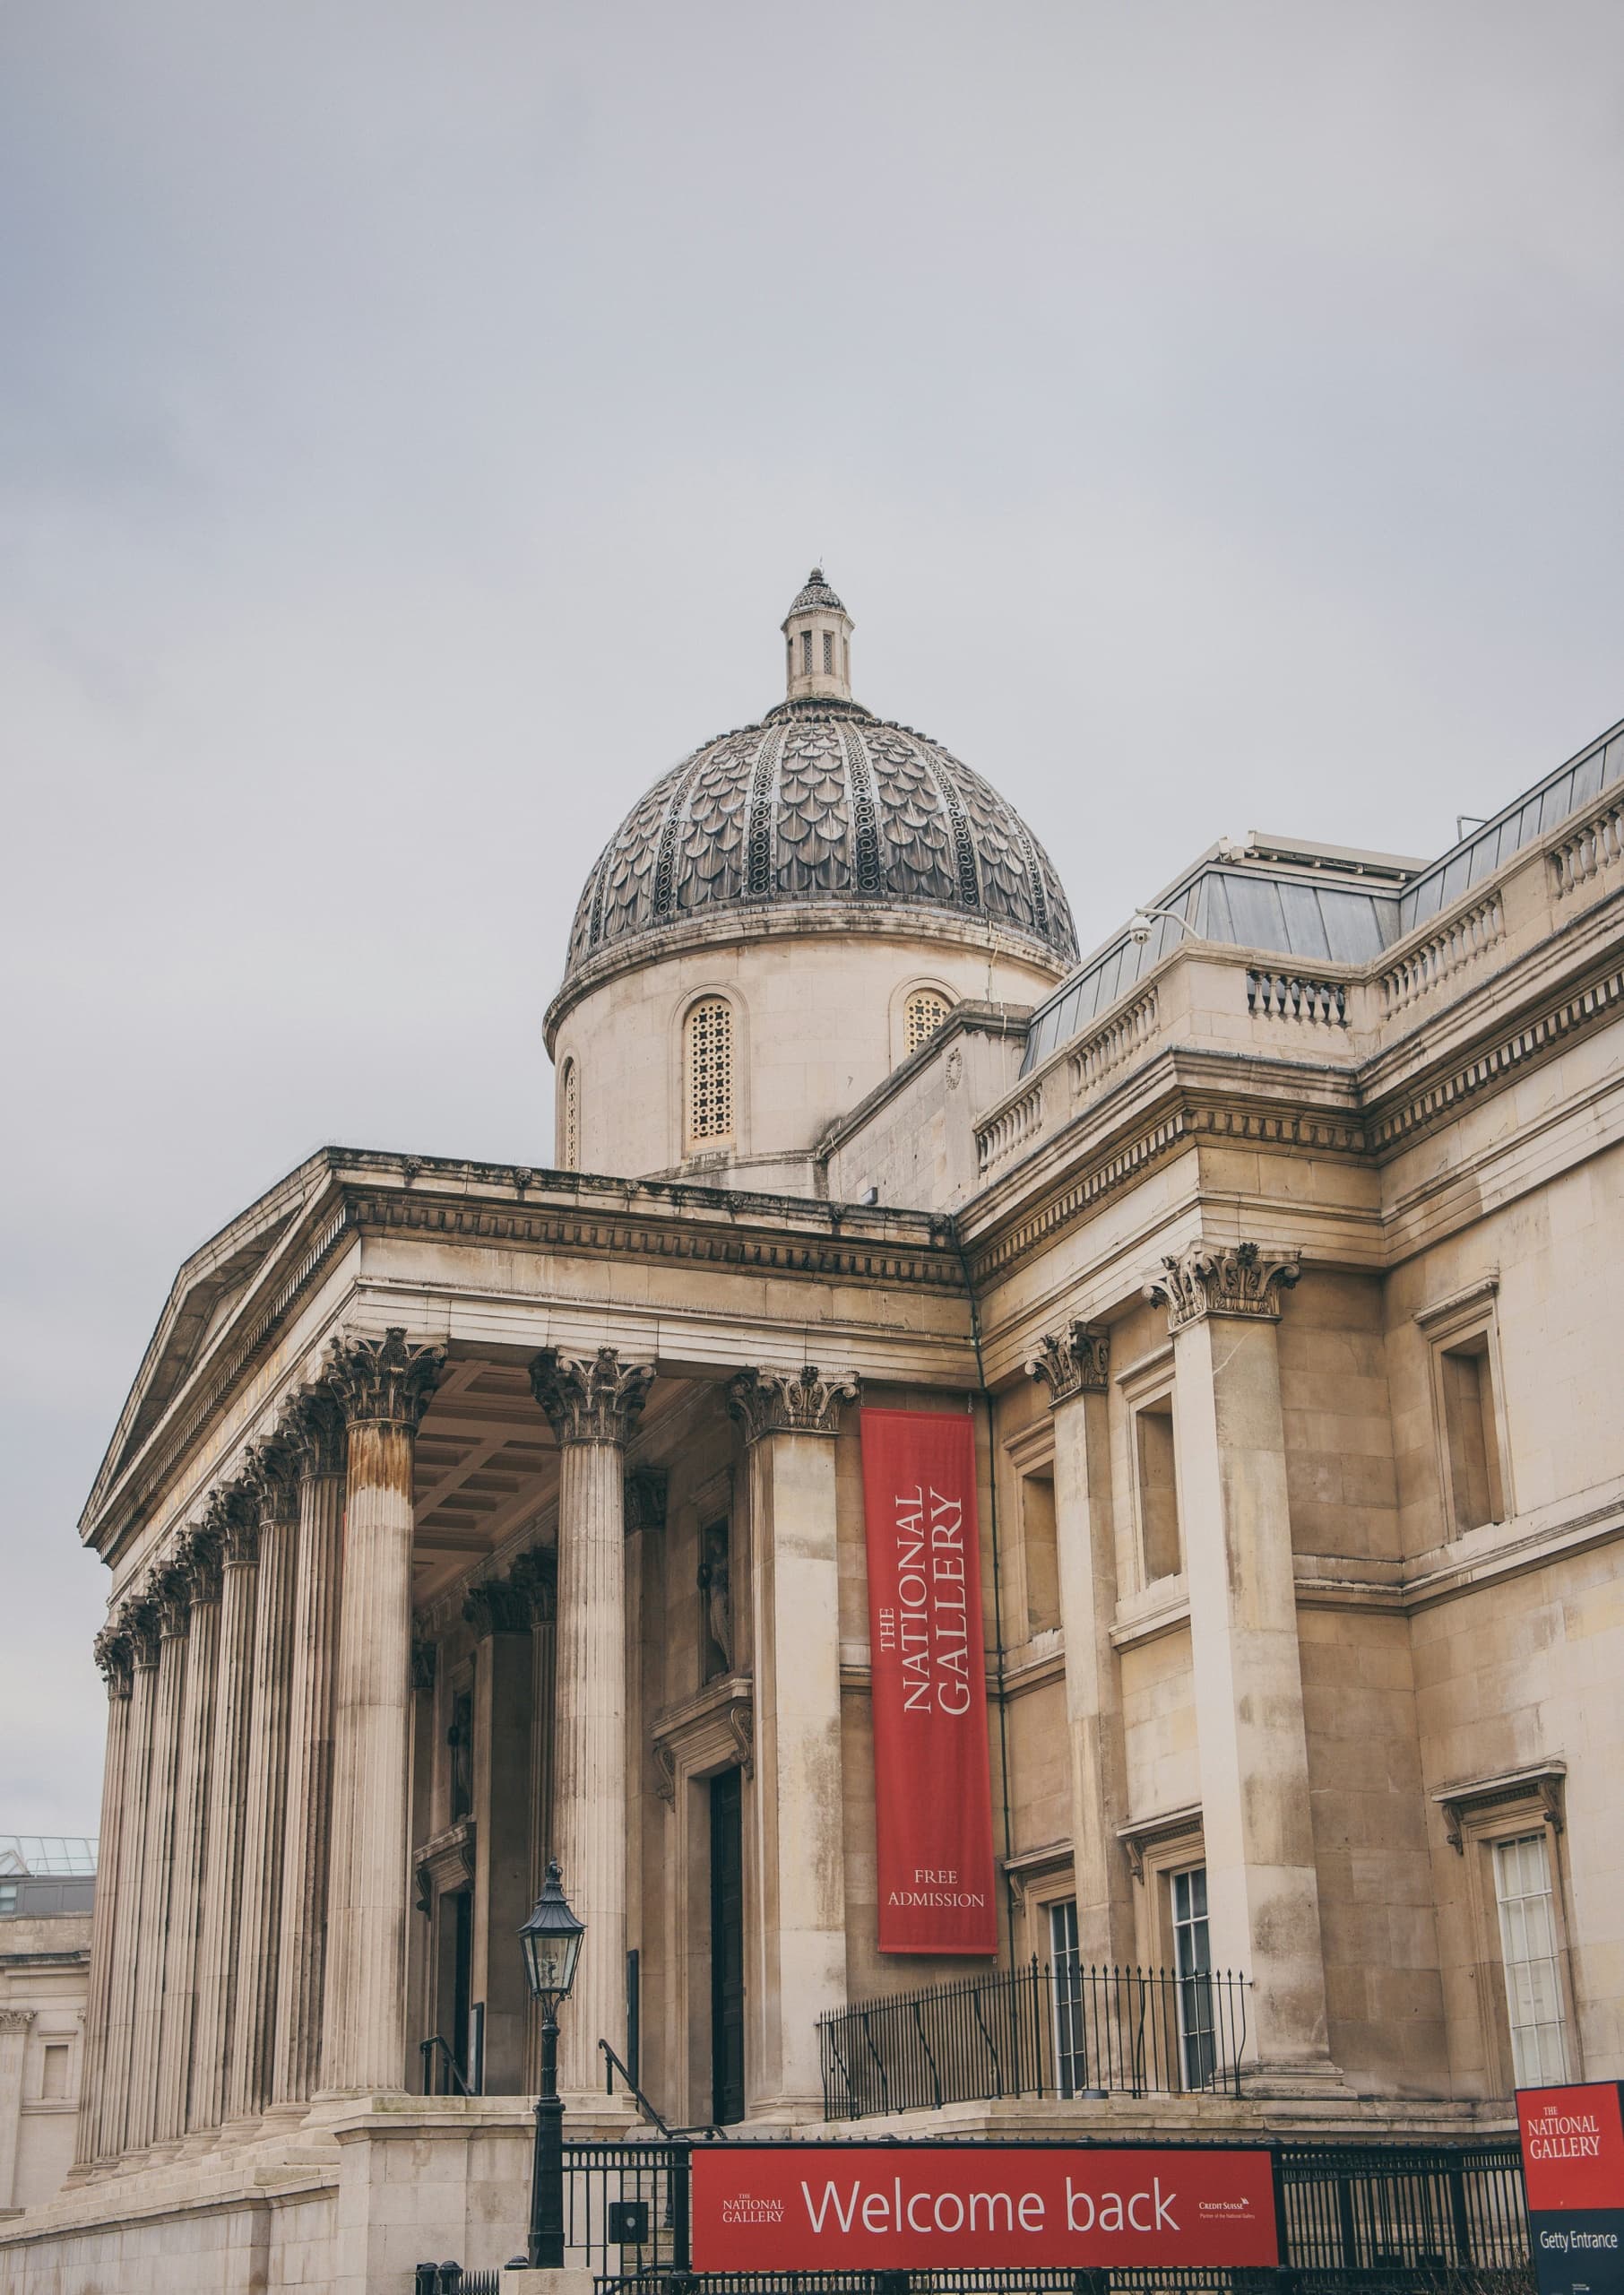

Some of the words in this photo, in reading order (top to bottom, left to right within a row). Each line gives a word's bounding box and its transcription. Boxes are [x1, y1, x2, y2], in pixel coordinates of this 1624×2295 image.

[894, 1485, 932, 1714] NATIONAL
[929, 1485, 971, 1715] GALLERY
[879, 1607, 895, 1652] THE
[914, 1869, 958, 1884] FREE
[887, 1892, 985, 1908] ADMISSION
[1543, 2106, 1558, 2116] THE
[1527, 2115, 1600, 2137] NATIONAL
[1529, 2136, 1601, 2160] GALLERY
[722, 2199, 784, 2210] NATIONAL
[800, 2177, 1045, 2233] Welcome
[1066, 2177, 1180, 2231] back
[722, 2211, 784, 2223] GALLERY
[1540, 2230, 1568, 2253] Getty
[1569, 2230, 1618, 2248] Entrance
